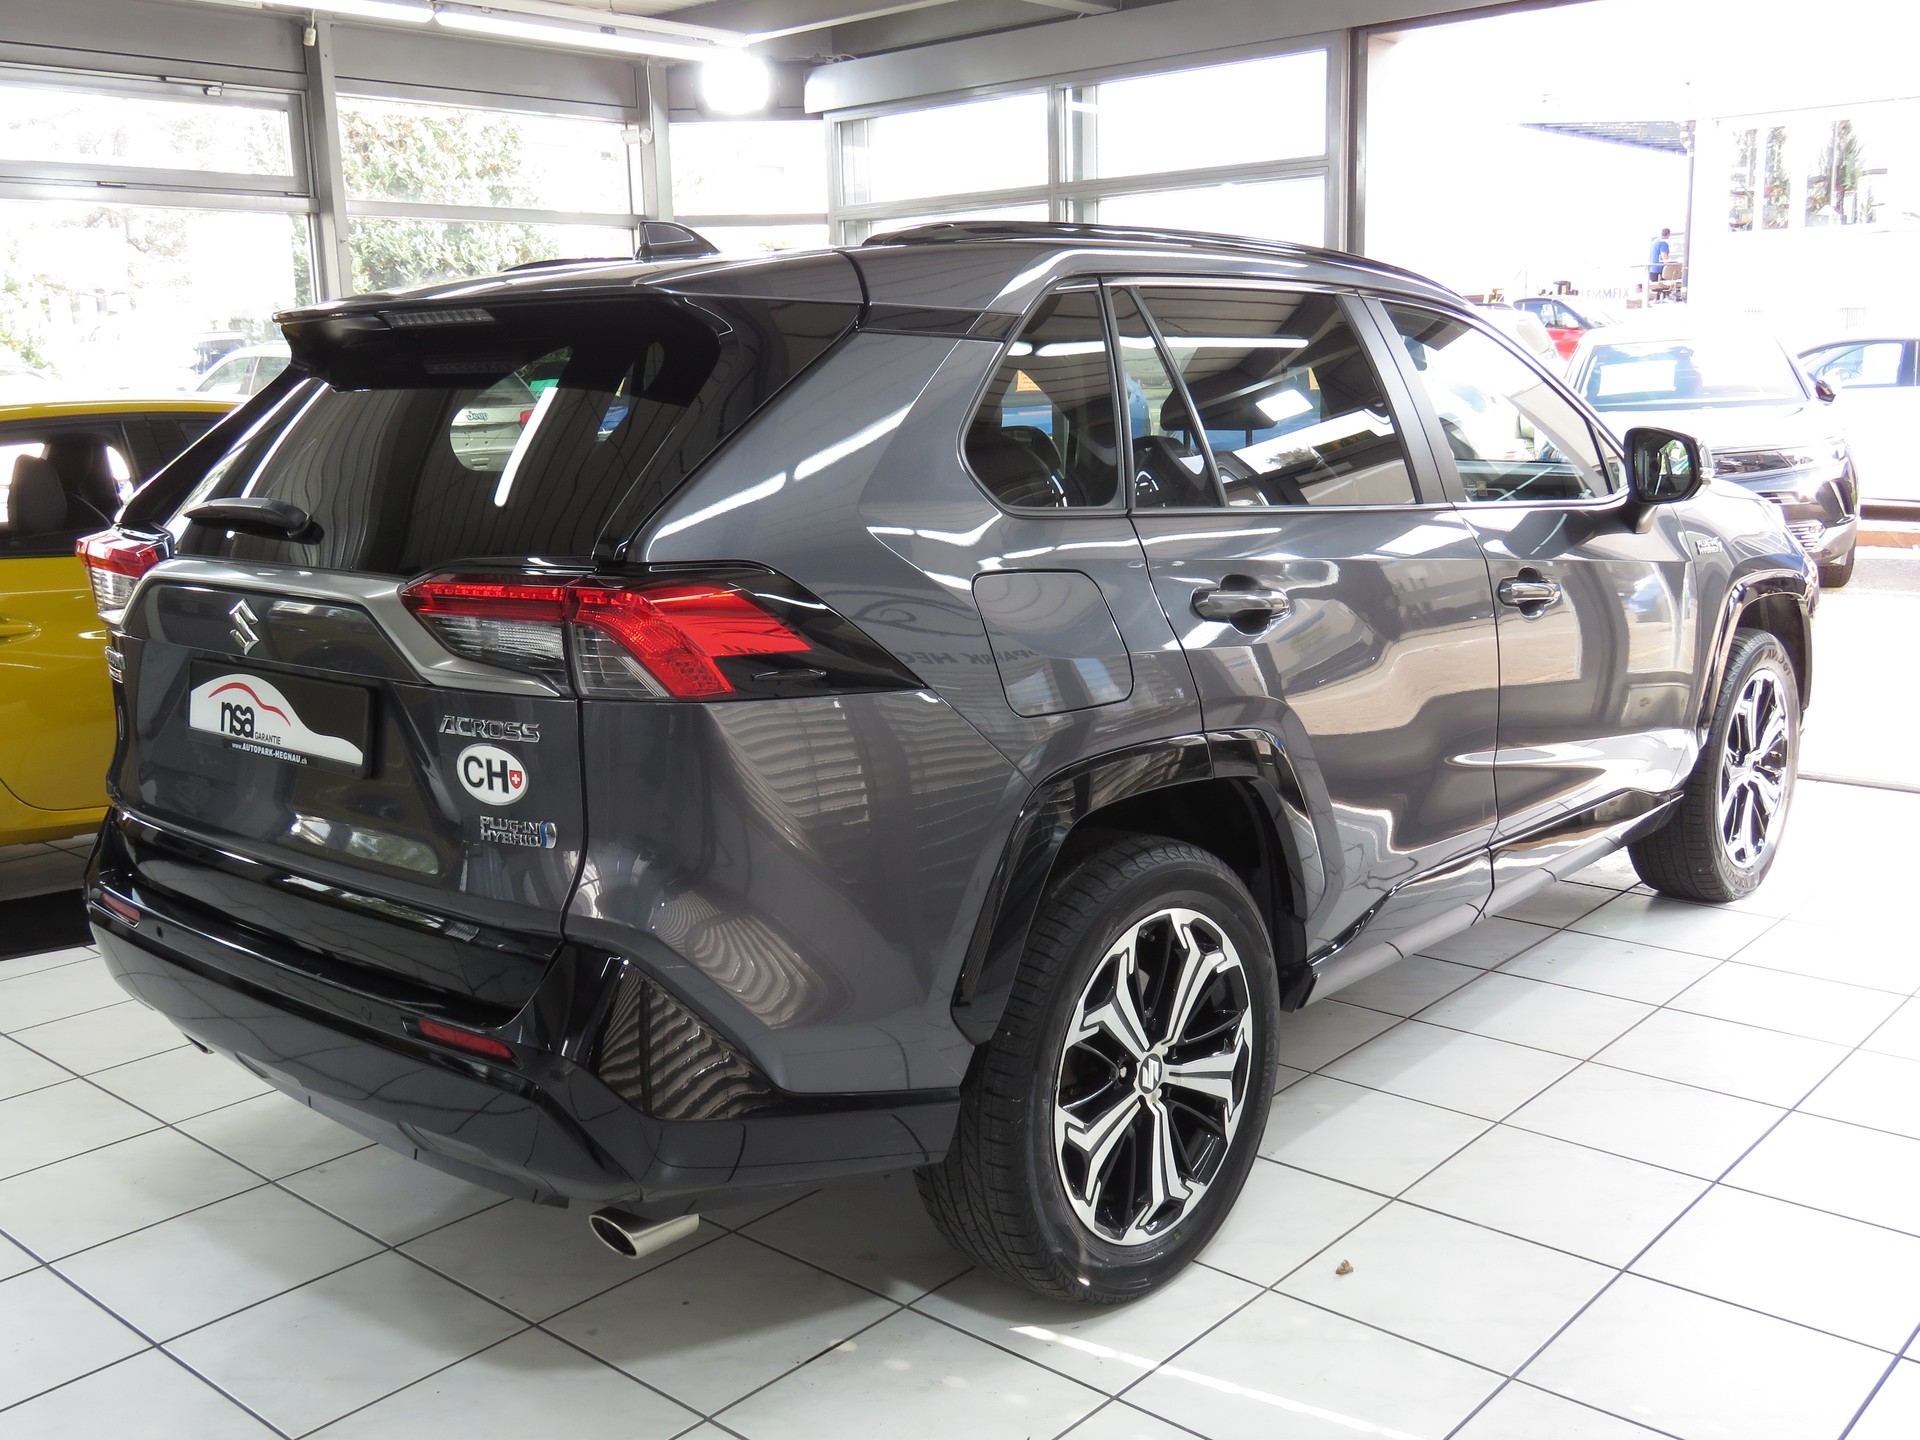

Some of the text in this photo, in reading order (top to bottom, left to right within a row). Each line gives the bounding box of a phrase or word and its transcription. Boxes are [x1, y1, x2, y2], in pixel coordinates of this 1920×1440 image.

[466, 410, 489, 421] Jeep
[220, 701, 255, 739] nsa
[438, 714, 541, 743] ACROSS
[254, 731, 281, 745] GARANTIE
[231, 742, 308, 765] www.AUTOPARK-HEGNAU.ch
[463, 755, 510, 794] CH
[480, 815, 541, 835] PLUG-IN
[480, 828, 542, 847] HYBRID
